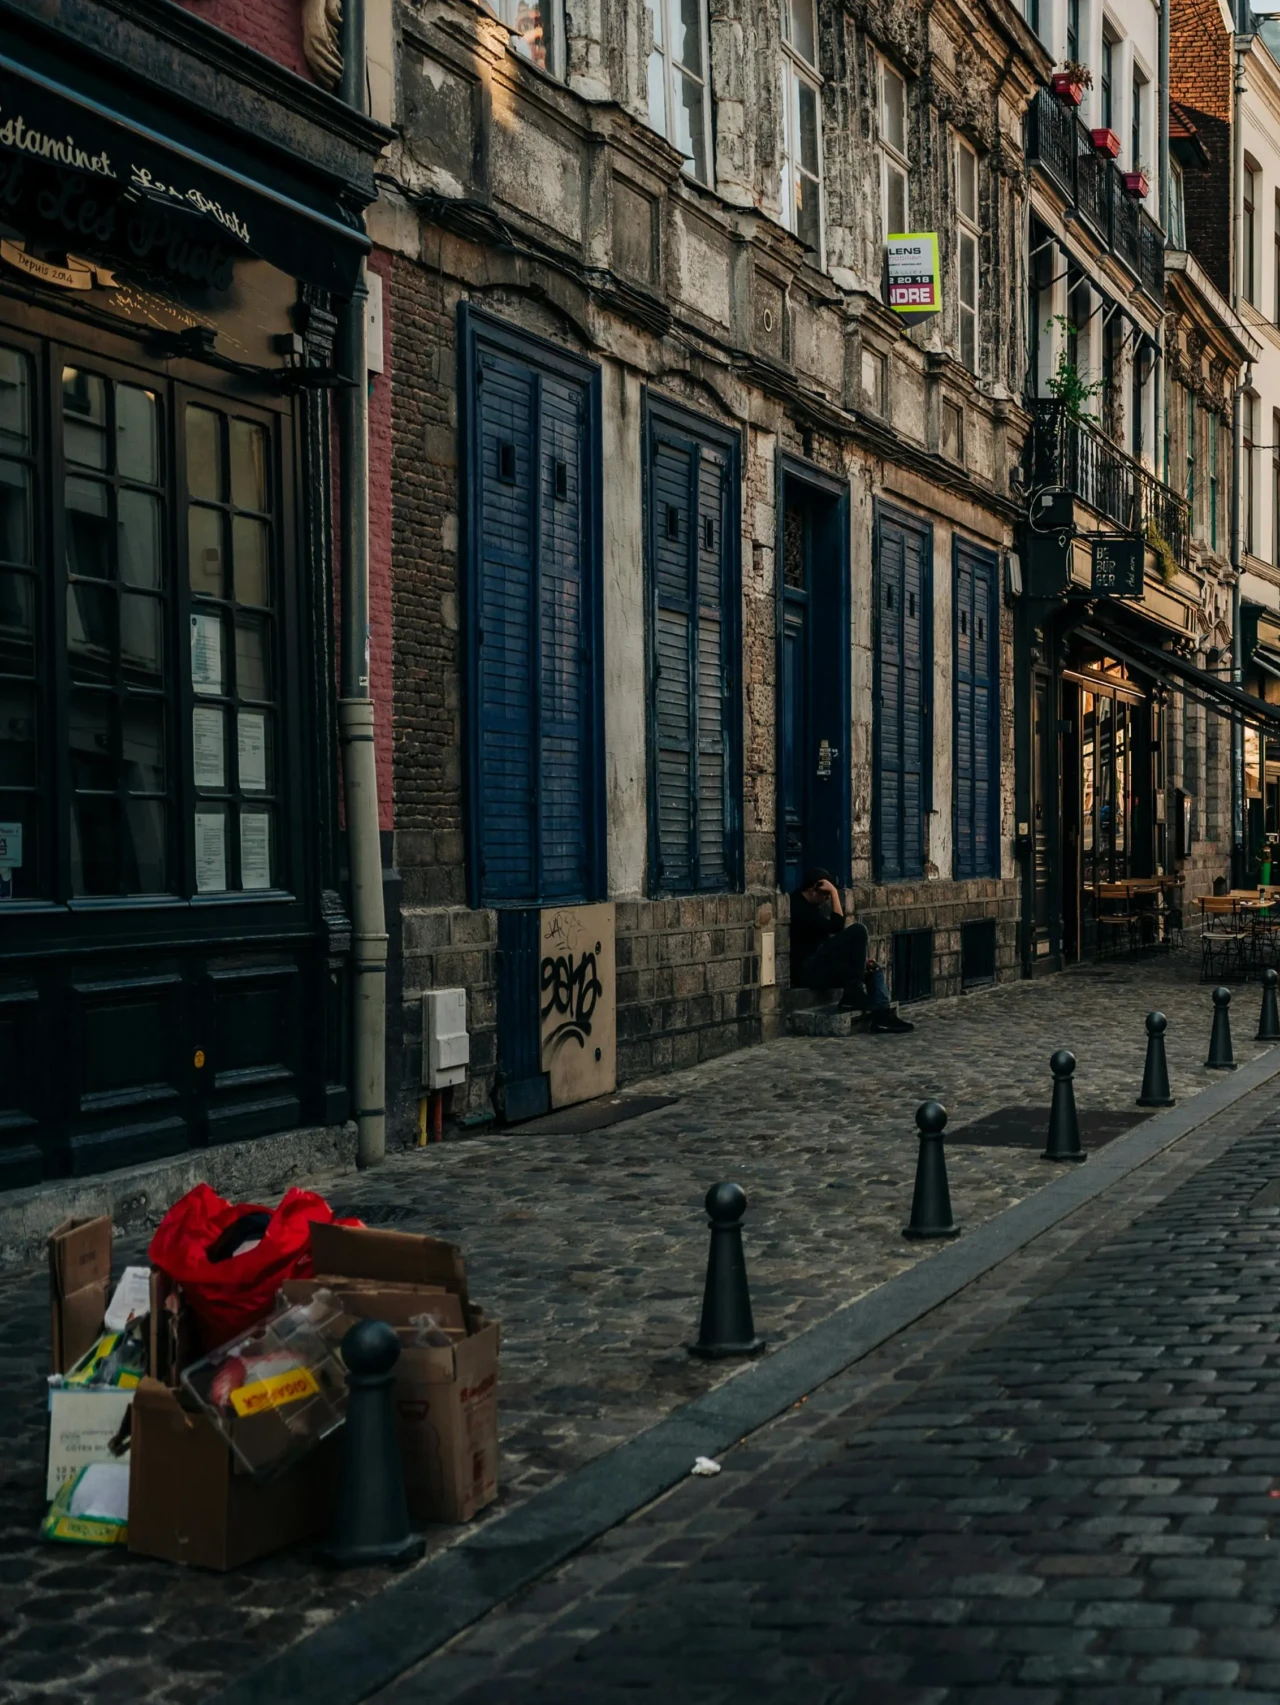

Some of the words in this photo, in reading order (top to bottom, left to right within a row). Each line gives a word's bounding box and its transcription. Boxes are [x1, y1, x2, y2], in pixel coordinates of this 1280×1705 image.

[0, 106, 118, 179] staminet
[889, 247, 921, 256] LENS
[17, 252, 49, 276] Depuis
[52, 269, 74, 284] 2014
[898, 276, 911, 284] 20
[1096, 547, 1109, 560] BE
[1096, 560, 1116, 573] BUR
[1096, 574, 1116, 587] GER
